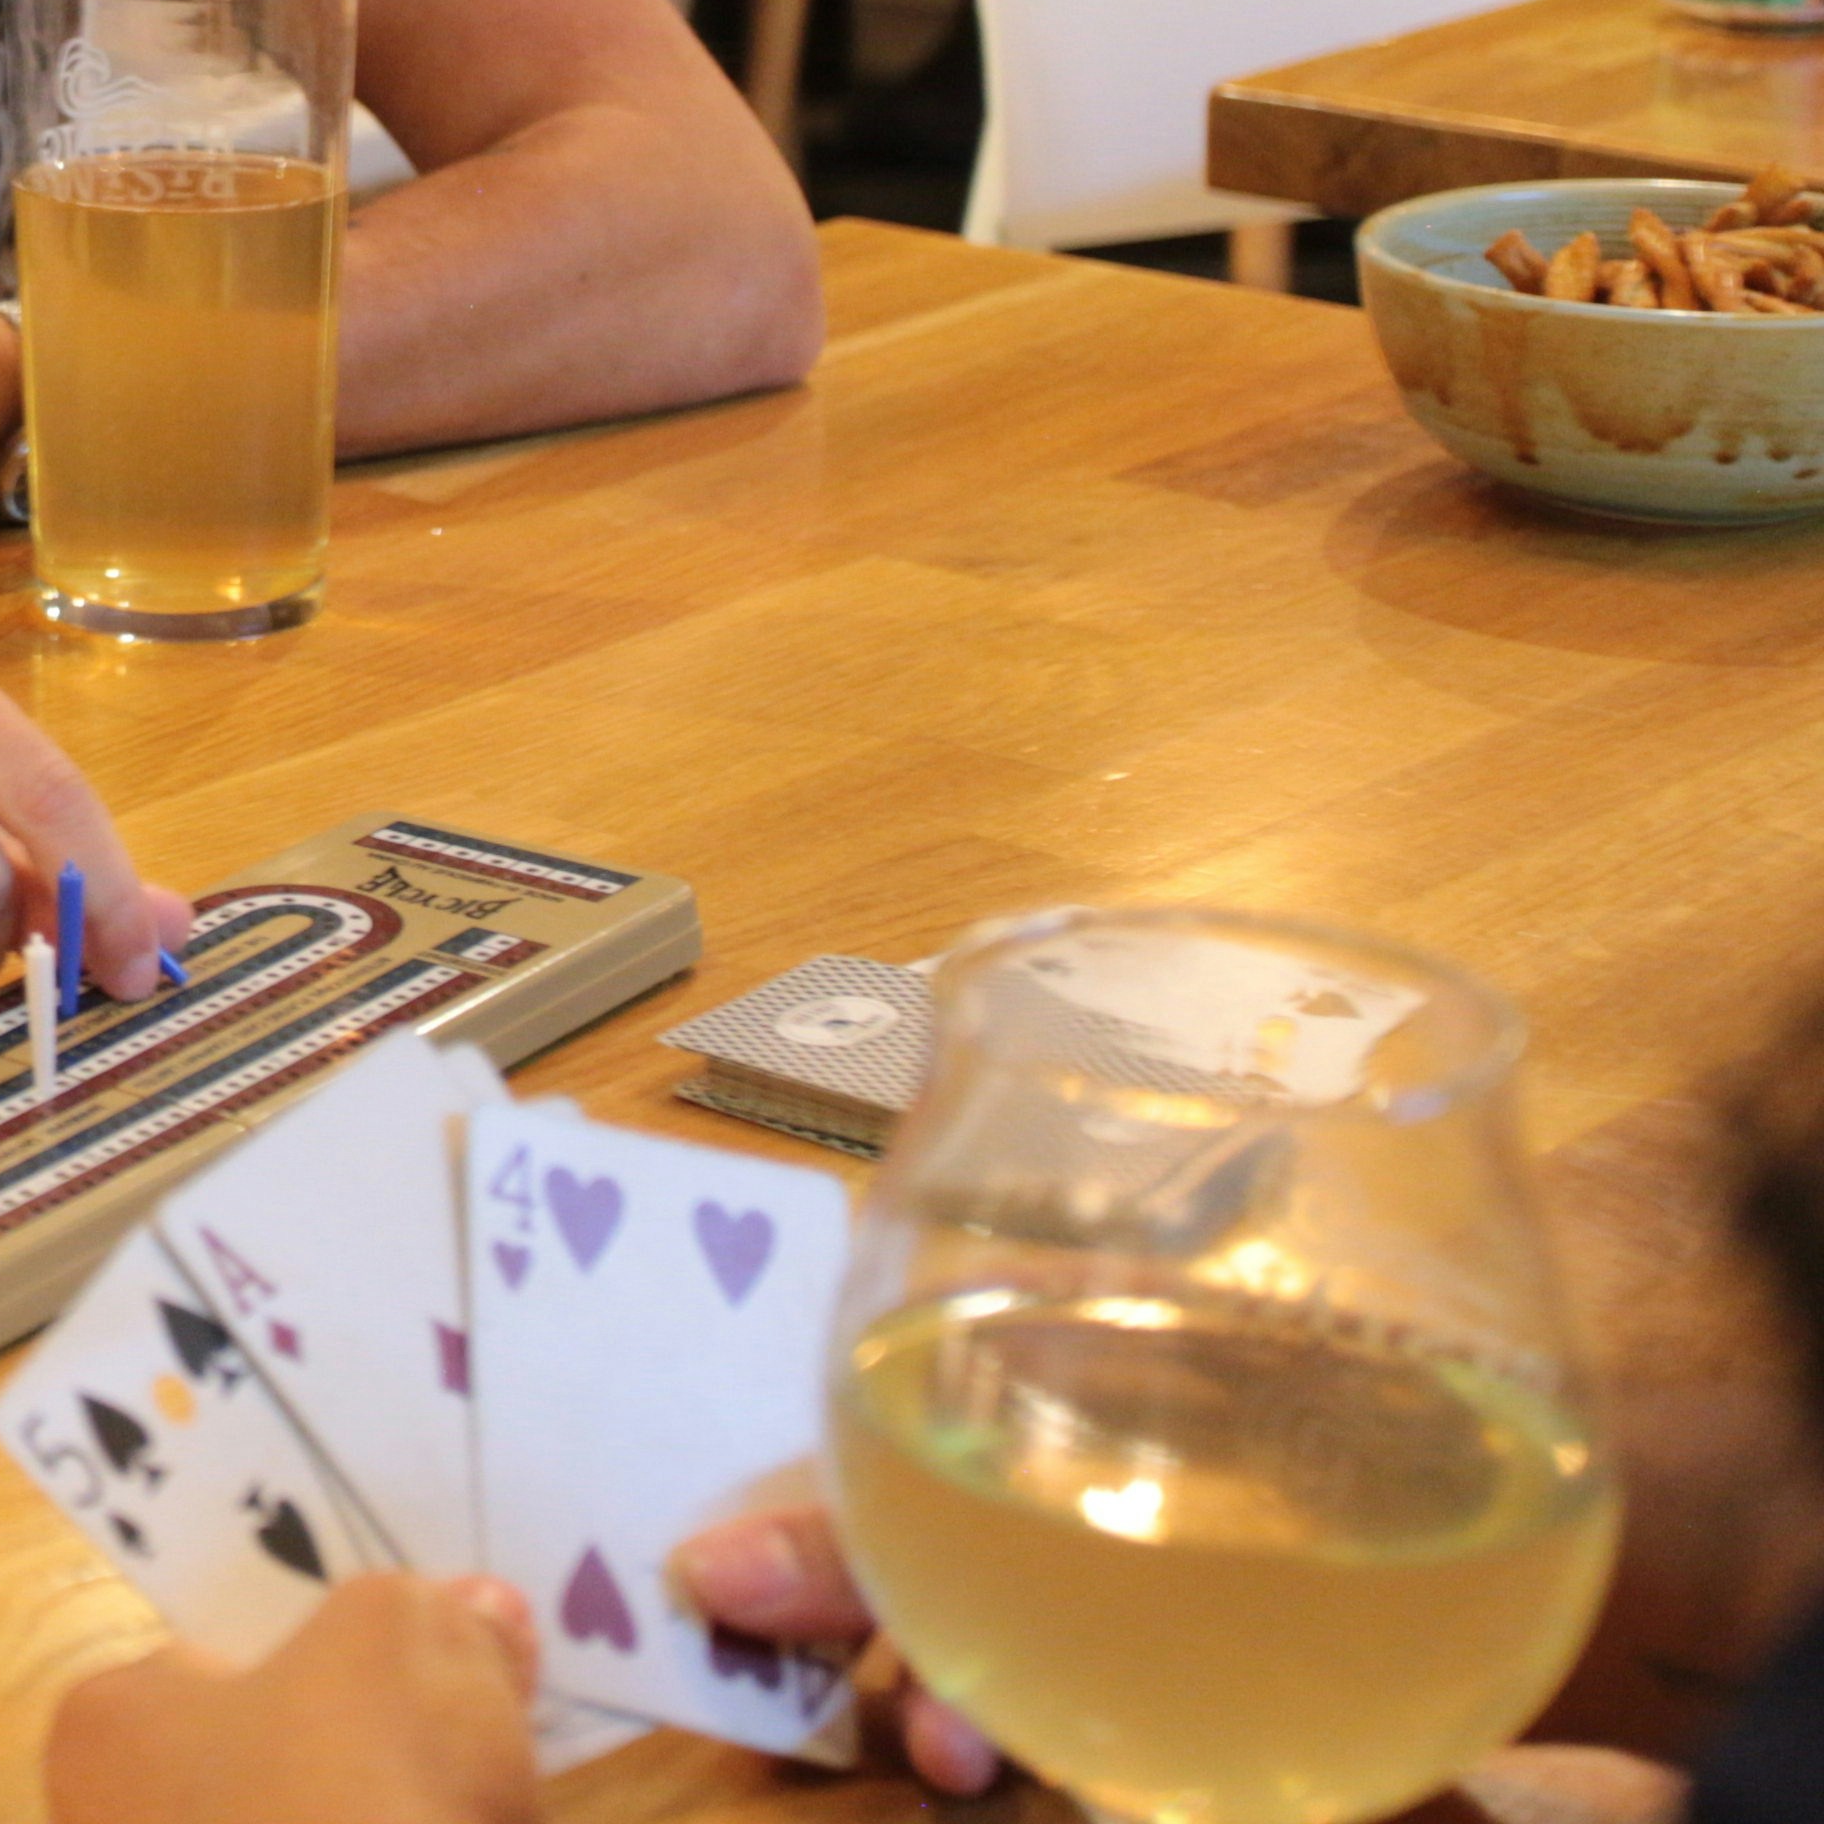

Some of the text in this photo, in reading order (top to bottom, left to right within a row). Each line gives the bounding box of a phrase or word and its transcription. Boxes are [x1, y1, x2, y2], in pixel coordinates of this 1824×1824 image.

[355, 865, 524, 920] BICYCLE
[487, 1142, 538, 1236] 4
[197, 1223, 278, 1316] A
[20, 1408, 105, 1510] 5
